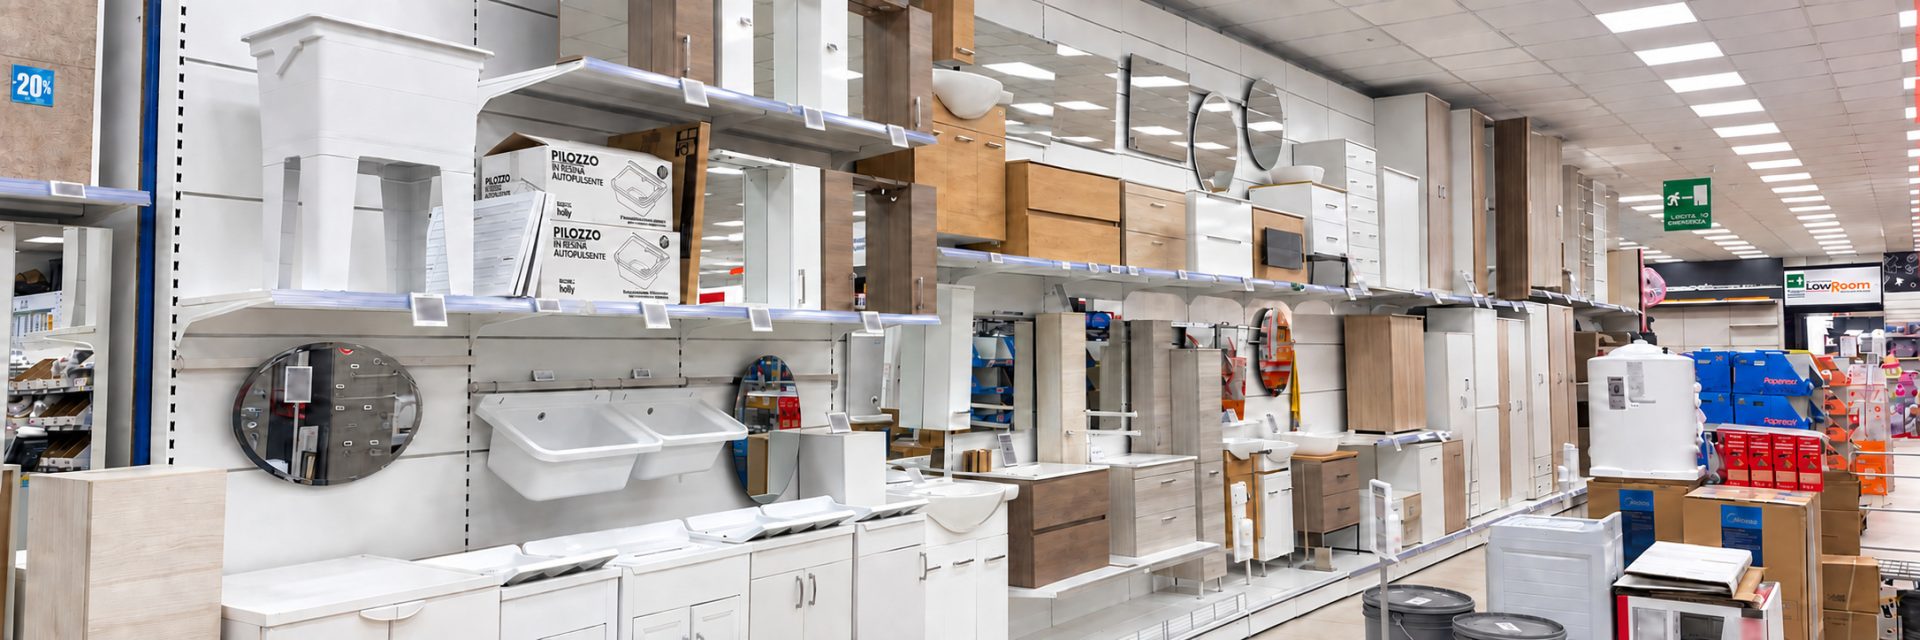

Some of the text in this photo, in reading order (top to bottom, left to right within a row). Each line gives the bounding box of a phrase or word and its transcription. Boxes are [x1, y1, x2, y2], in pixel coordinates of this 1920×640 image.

[12, 72, 52, 98] -20%
[552, 150, 599, 166] PILOZZO
[552, 163, 585, 175] IN RESINA
[553, 226, 601, 241] PILOZZO
[553, 240, 587, 250] IN RESINA
[559, 284, 575, 295] holly
